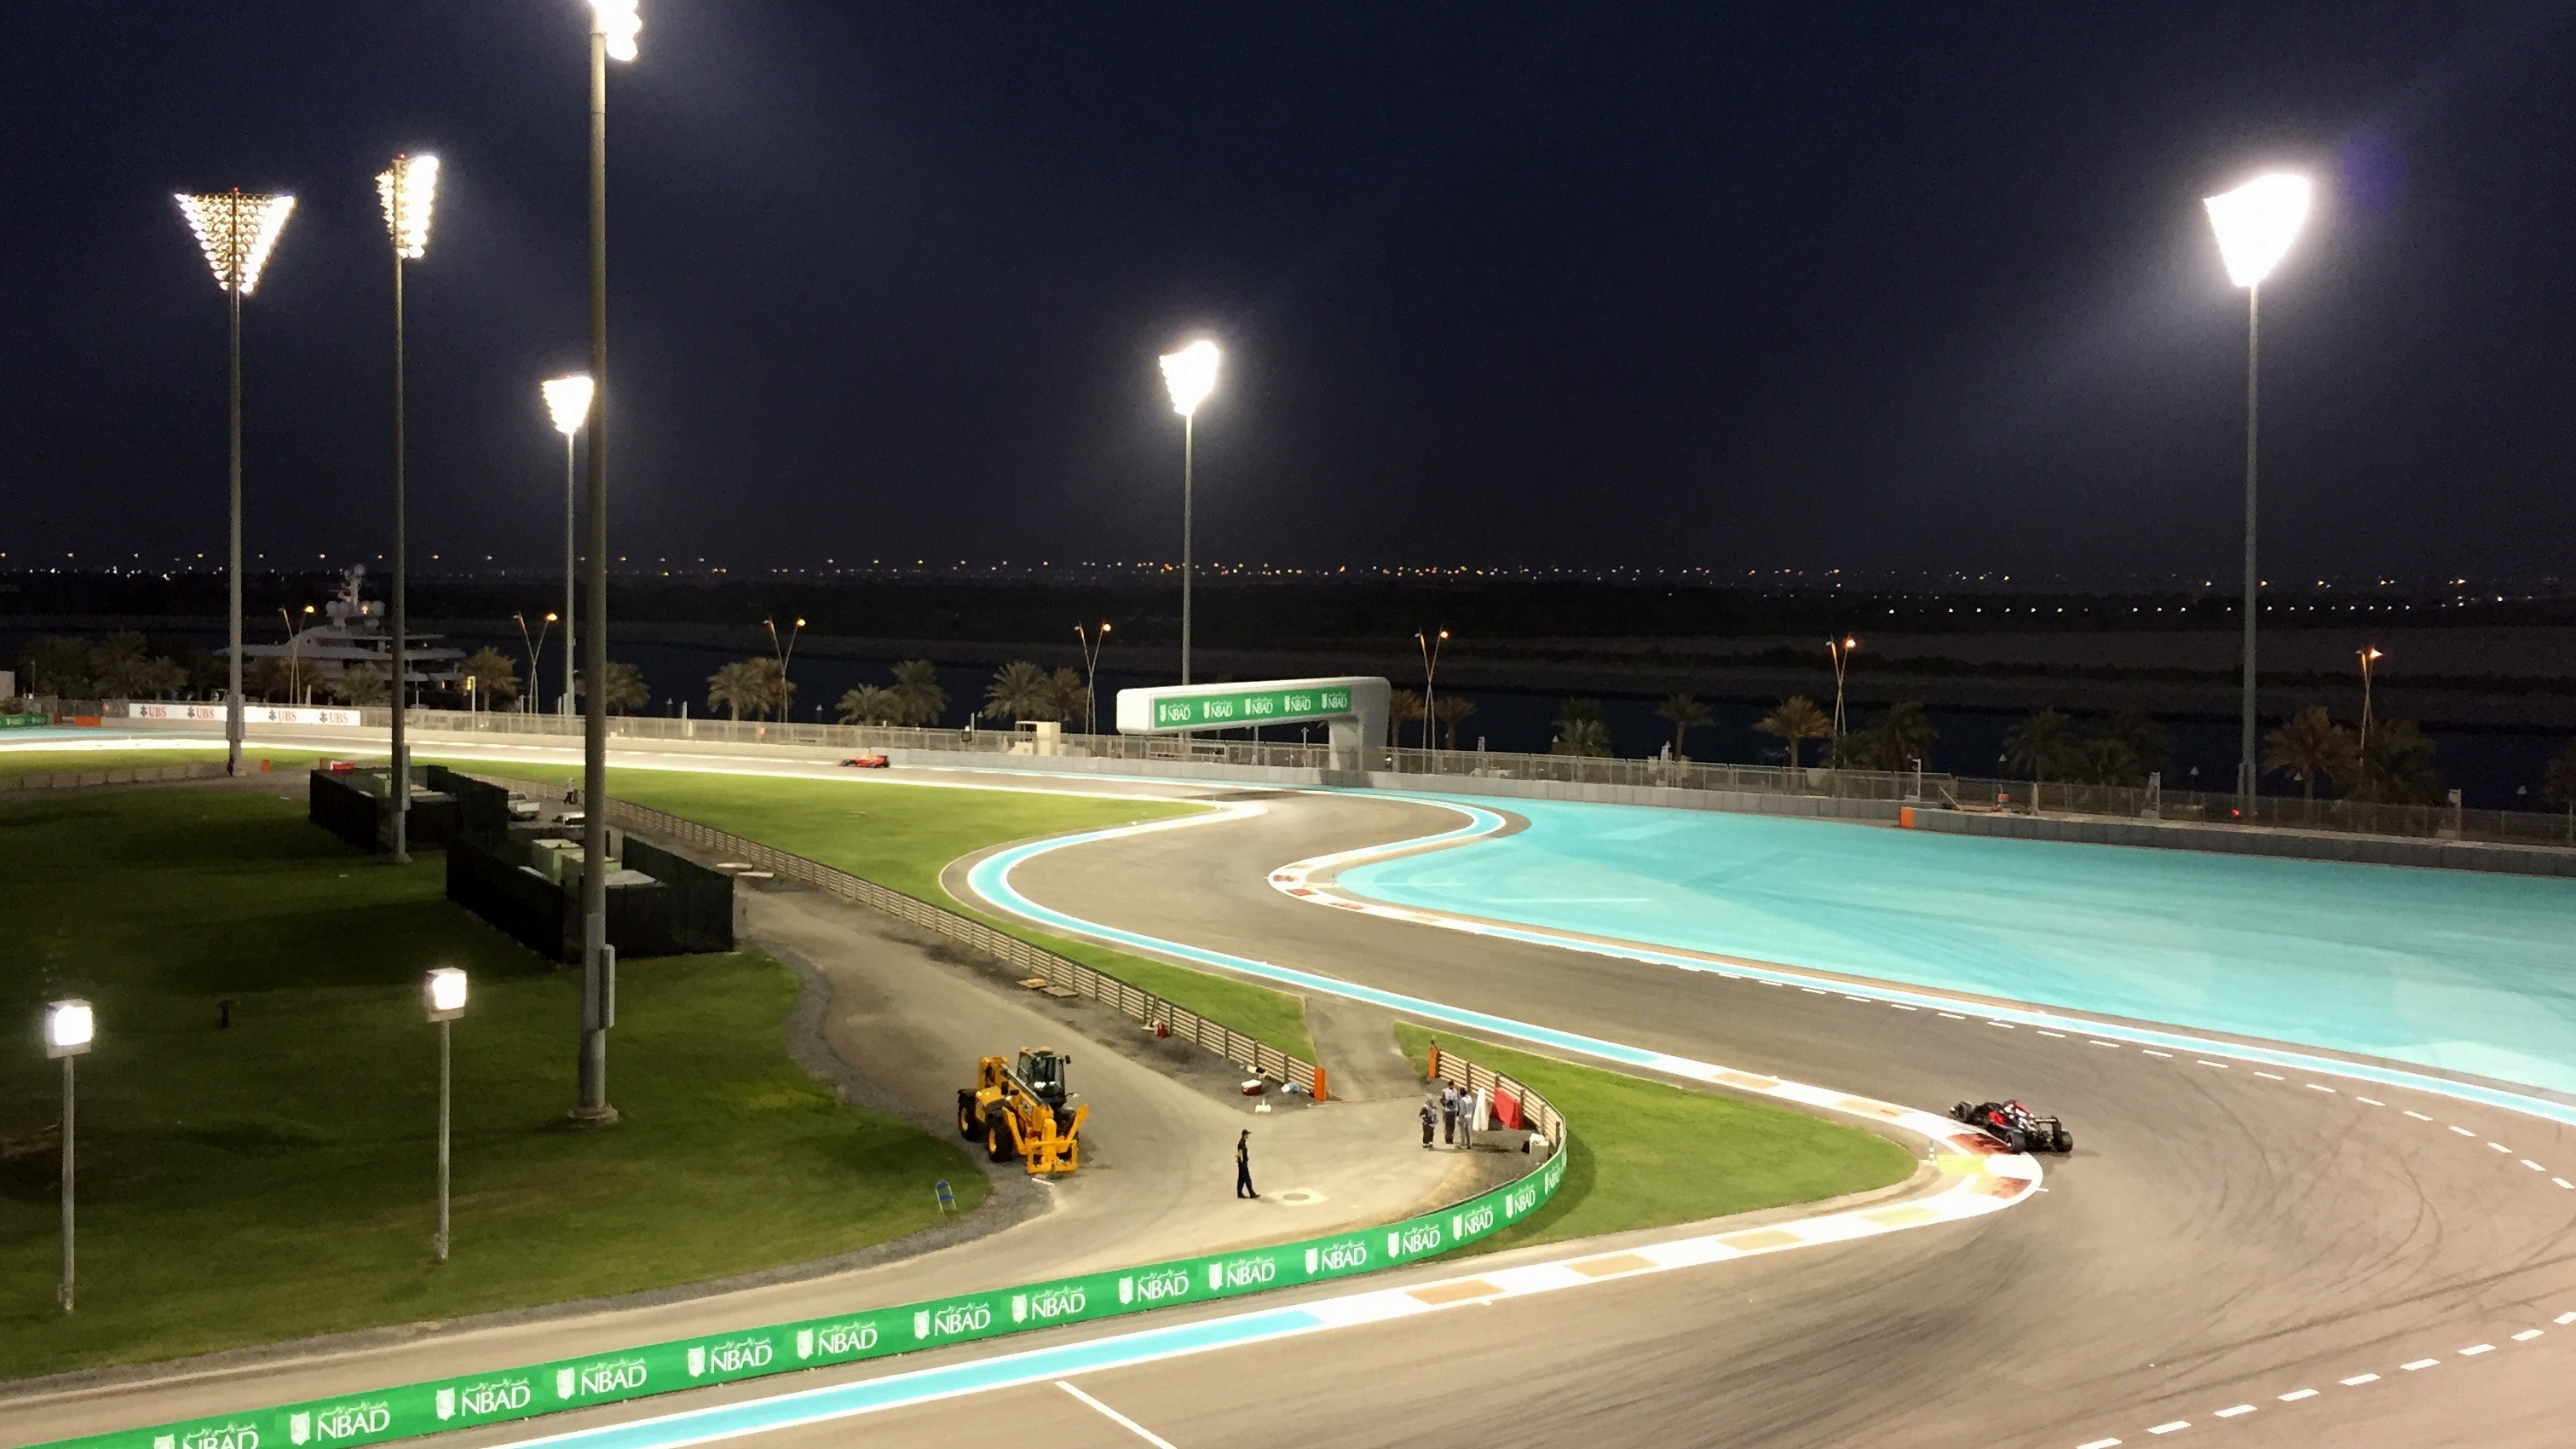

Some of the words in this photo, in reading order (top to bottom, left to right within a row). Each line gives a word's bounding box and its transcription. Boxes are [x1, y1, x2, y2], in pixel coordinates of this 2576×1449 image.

[148, 707, 166, 718] UBS
[196, 707, 214, 719] UBS
[1168, 707, 1190, 721] NBAD
[1211, 703, 1233, 718] NBAD
[1252, 701, 1273, 714] NBAD
[1291, 698, 1311, 712] NBAD
[1327, 696, 1347, 709] NBAD
[278, 710, 297, 722] UBS
[330, 712, 349, 724] UBS
[1514, 1189, 1536, 1215] NBAD
[1465, 1210, 1493, 1237] NBAD
[1403, 1229, 1440, 1255] NBAD
[1322, 1247, 1367, 1272] NBAD
[1227, 1262, 1276, 1288] NBAD
[1138, 1276, 1189, 1302] NBAD
[1032, 1292, 1086, 1320] NBAD
[935, 1309, 991, 1336] NBAD
[818, 1327, 878, 1356] NBAD
[711, 1344, 773, 1373] NBAD
[581, 1364, 647, 1395] NBAD
[461, 1385, 531, 1417] NBAD
[318, 1409, 390, 1441] NBAD
